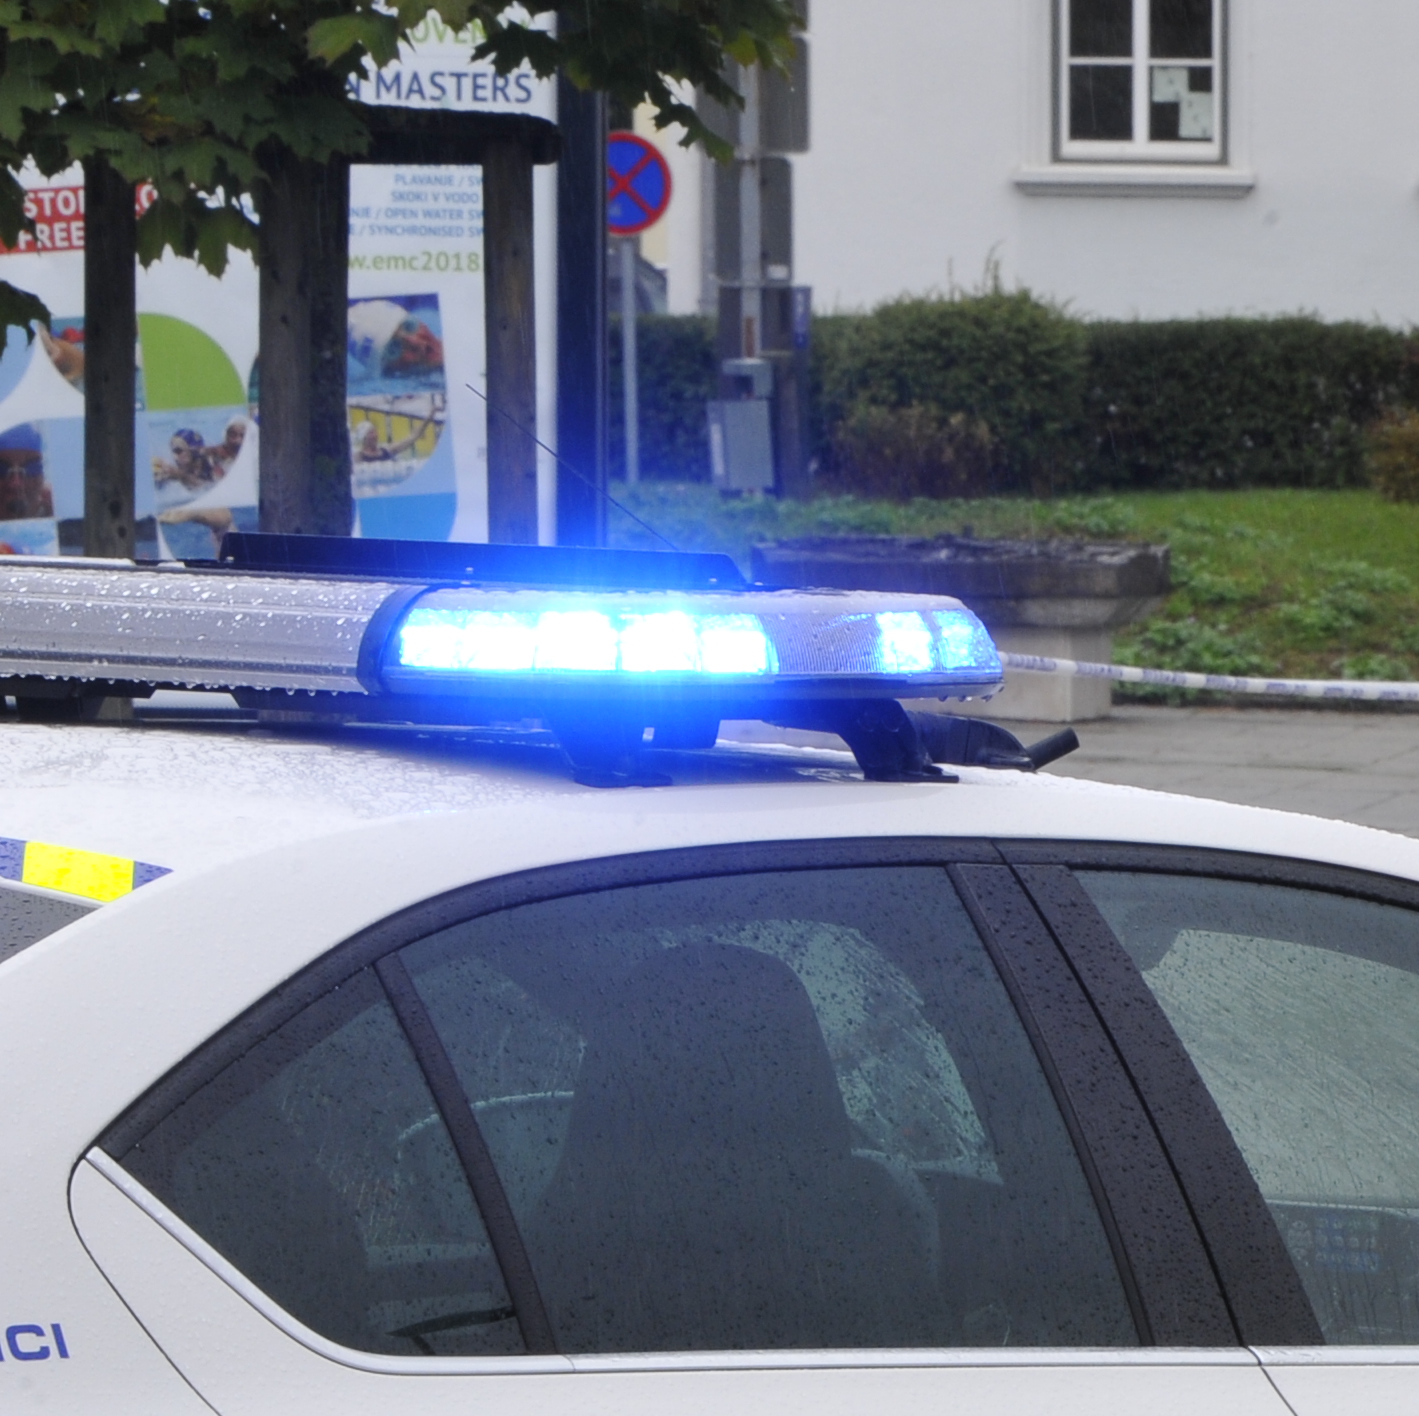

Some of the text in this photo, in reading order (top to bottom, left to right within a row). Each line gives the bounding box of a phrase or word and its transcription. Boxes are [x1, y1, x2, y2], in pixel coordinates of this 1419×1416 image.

[375, 71, 532, 103] MASTERS
[385, 207, 418, 219] OPEN
[422, 208, 464, 220] WATER
[349, 250, 480, 273] w.emc2018
